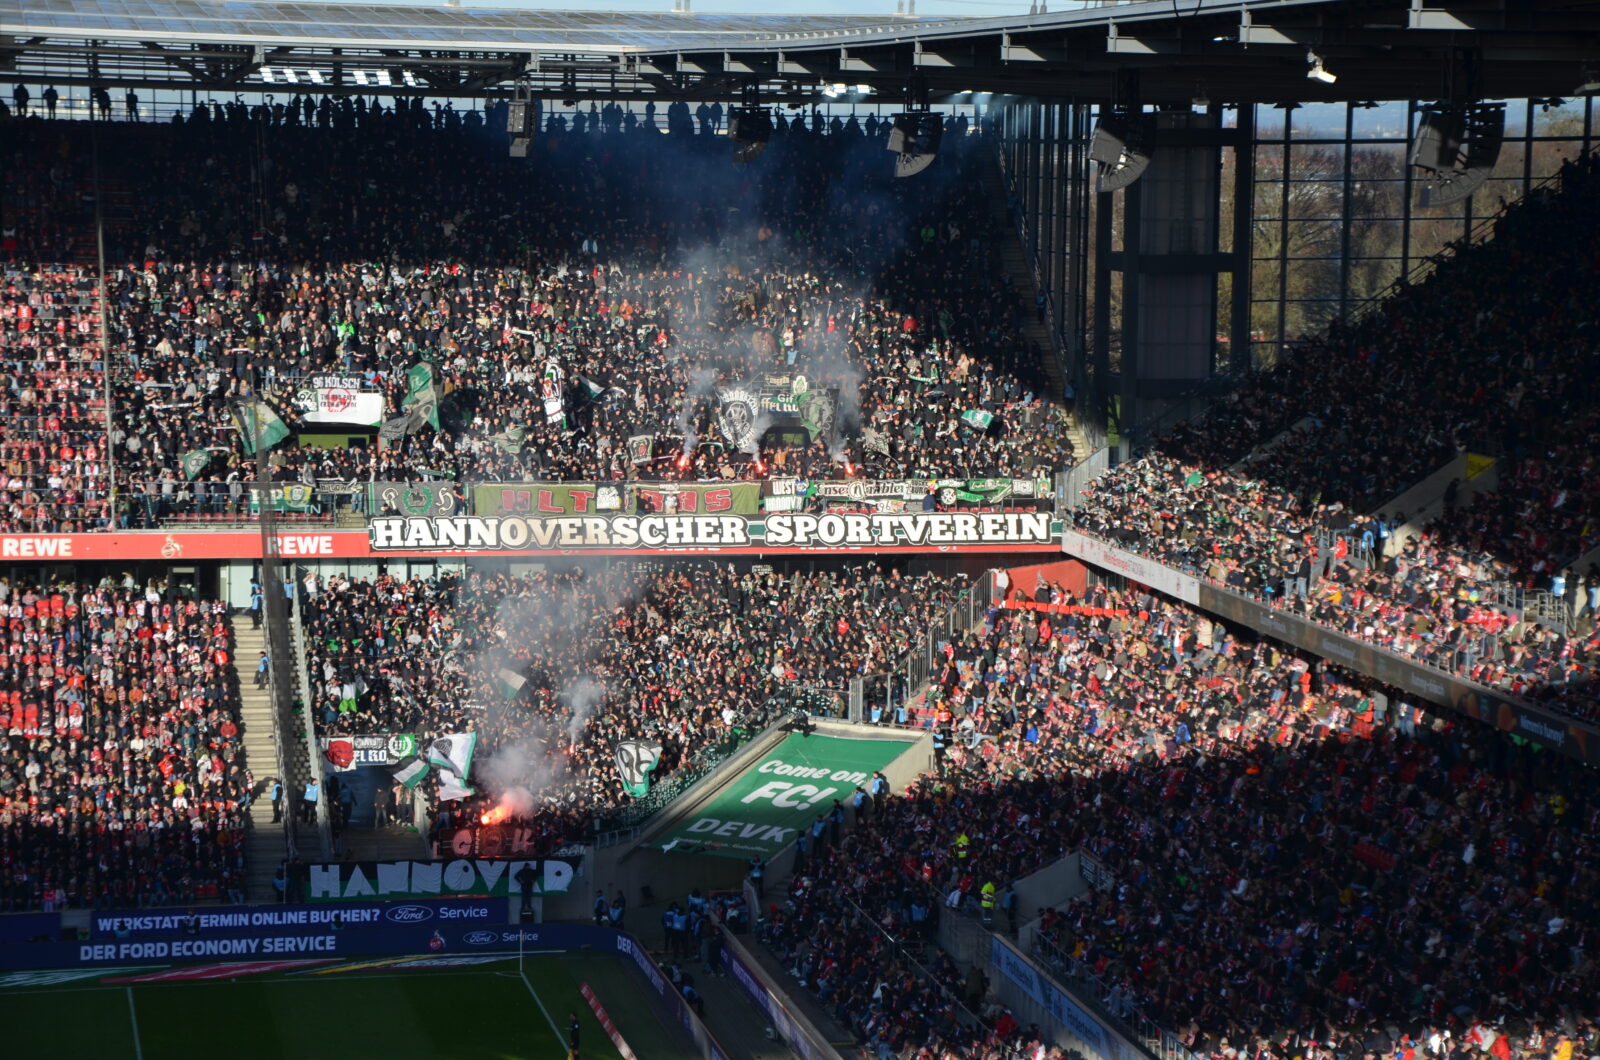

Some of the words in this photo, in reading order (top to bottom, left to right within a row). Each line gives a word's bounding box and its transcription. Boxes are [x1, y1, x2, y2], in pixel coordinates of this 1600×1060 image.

[772, 479, 796, 495] WEST
[372, 517, 747, 547] HANNOVERSCHER
[765, 514, 1049, 543] SPORTVEREIN
[3, 538, 73, 557] REWE
[267, 535, 333, 555] REWE
[758, 760, 831, 779] Come
[741, 781, 838, 811] FC!
[686, 818, 796, 842] DEVK
[98, 913, 249, 931] WERKSTATERMIN
[252, 911, 307, 926] ONLINE
[309, 909, 381, 924] BUCHEN?
[439, 906, 488, 919] Service
[502, 932, 538, 942] Service
[617, 935, 632, 954] DER
[80, 944, 116, 960] DER
[119, 942, 168, 959] FORD
[171, 939, 259, 956] ECONOMY
[262, 935, 336, 954] SERVICE
